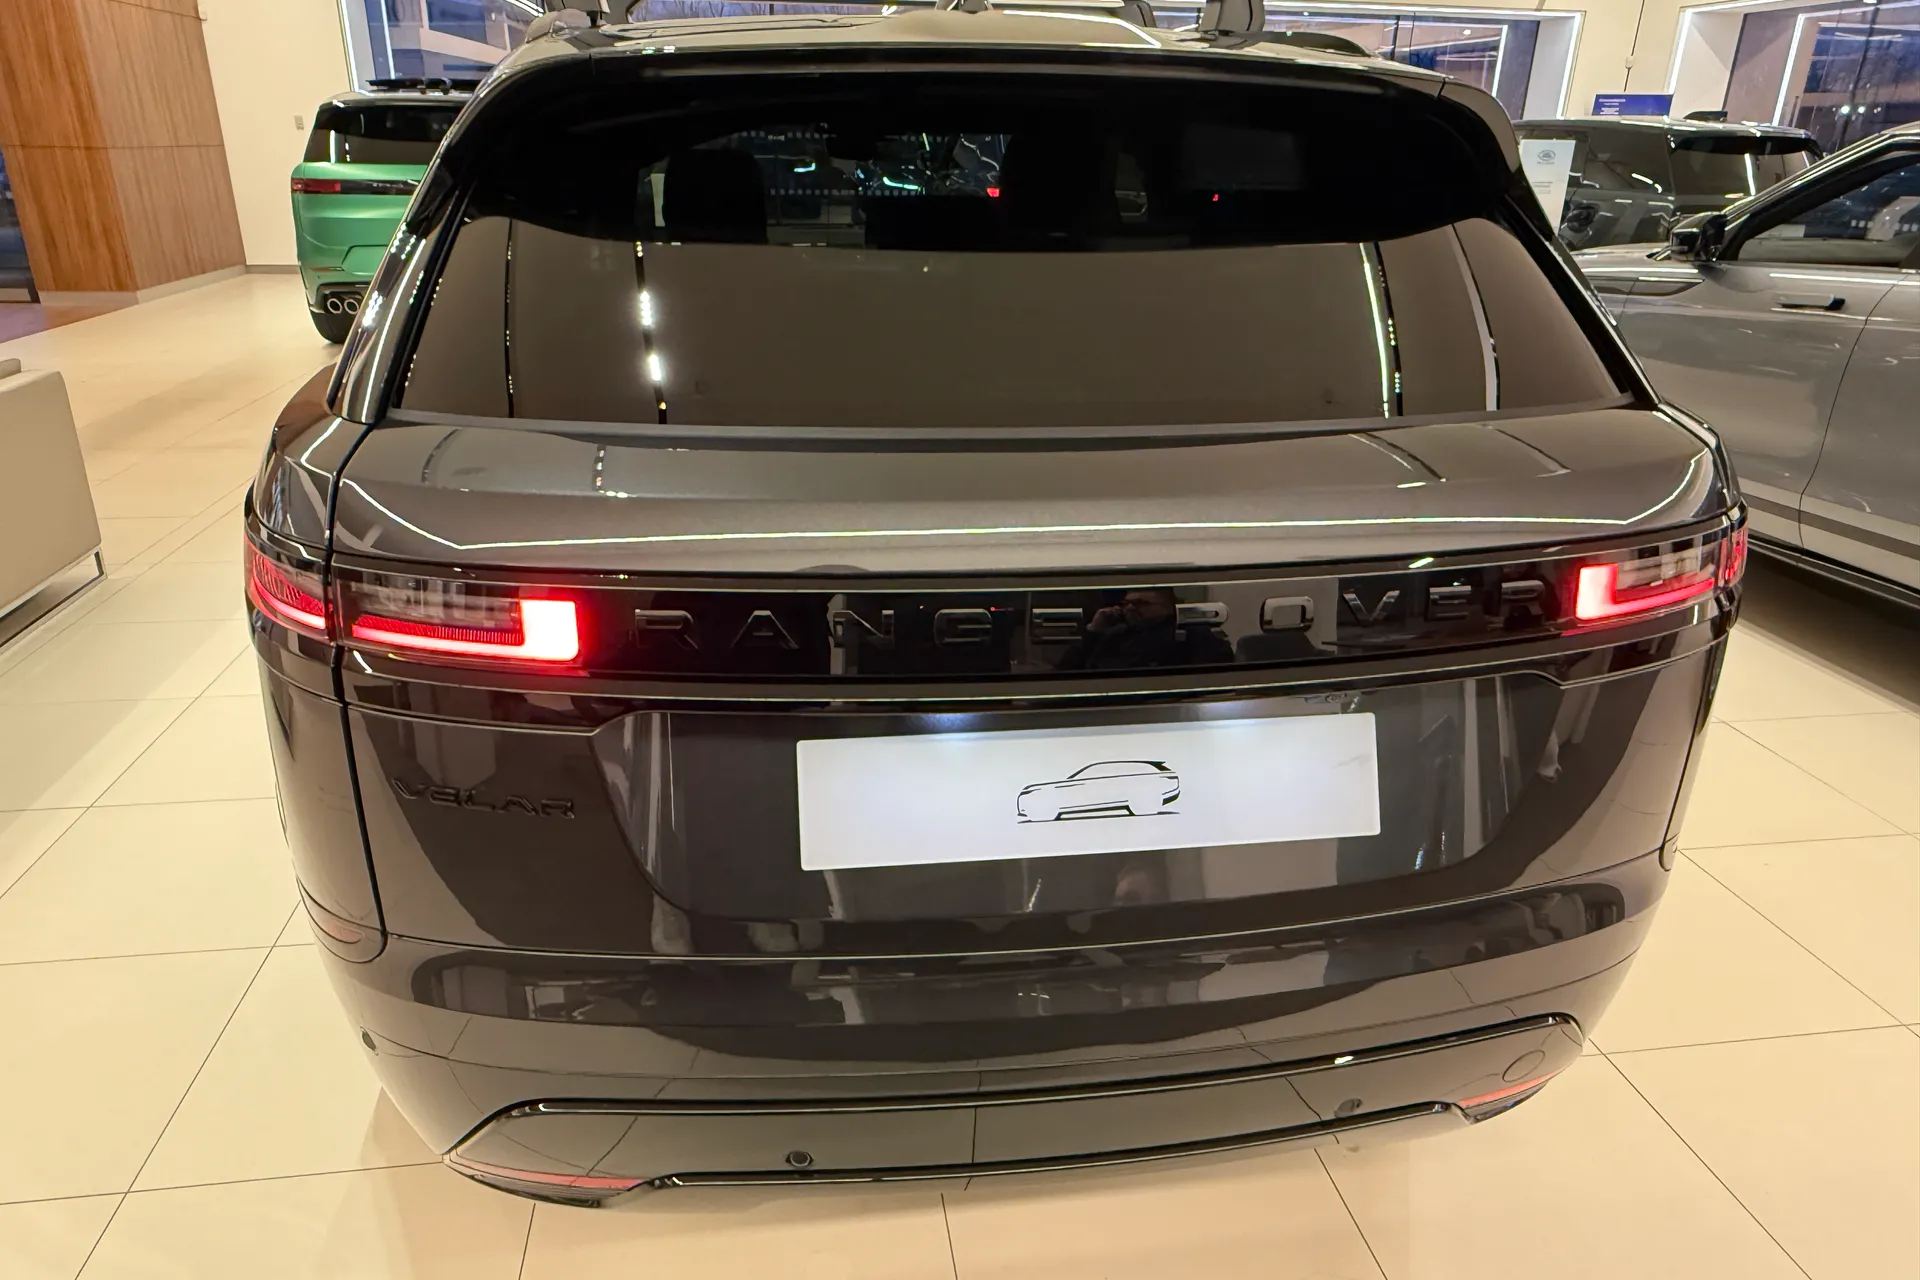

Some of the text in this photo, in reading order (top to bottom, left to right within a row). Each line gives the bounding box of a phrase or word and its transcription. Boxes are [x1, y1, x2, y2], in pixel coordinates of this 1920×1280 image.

[634, 579, 1546, 651] RANGE ROVER
[392, 778, 576, 820] VELAR
